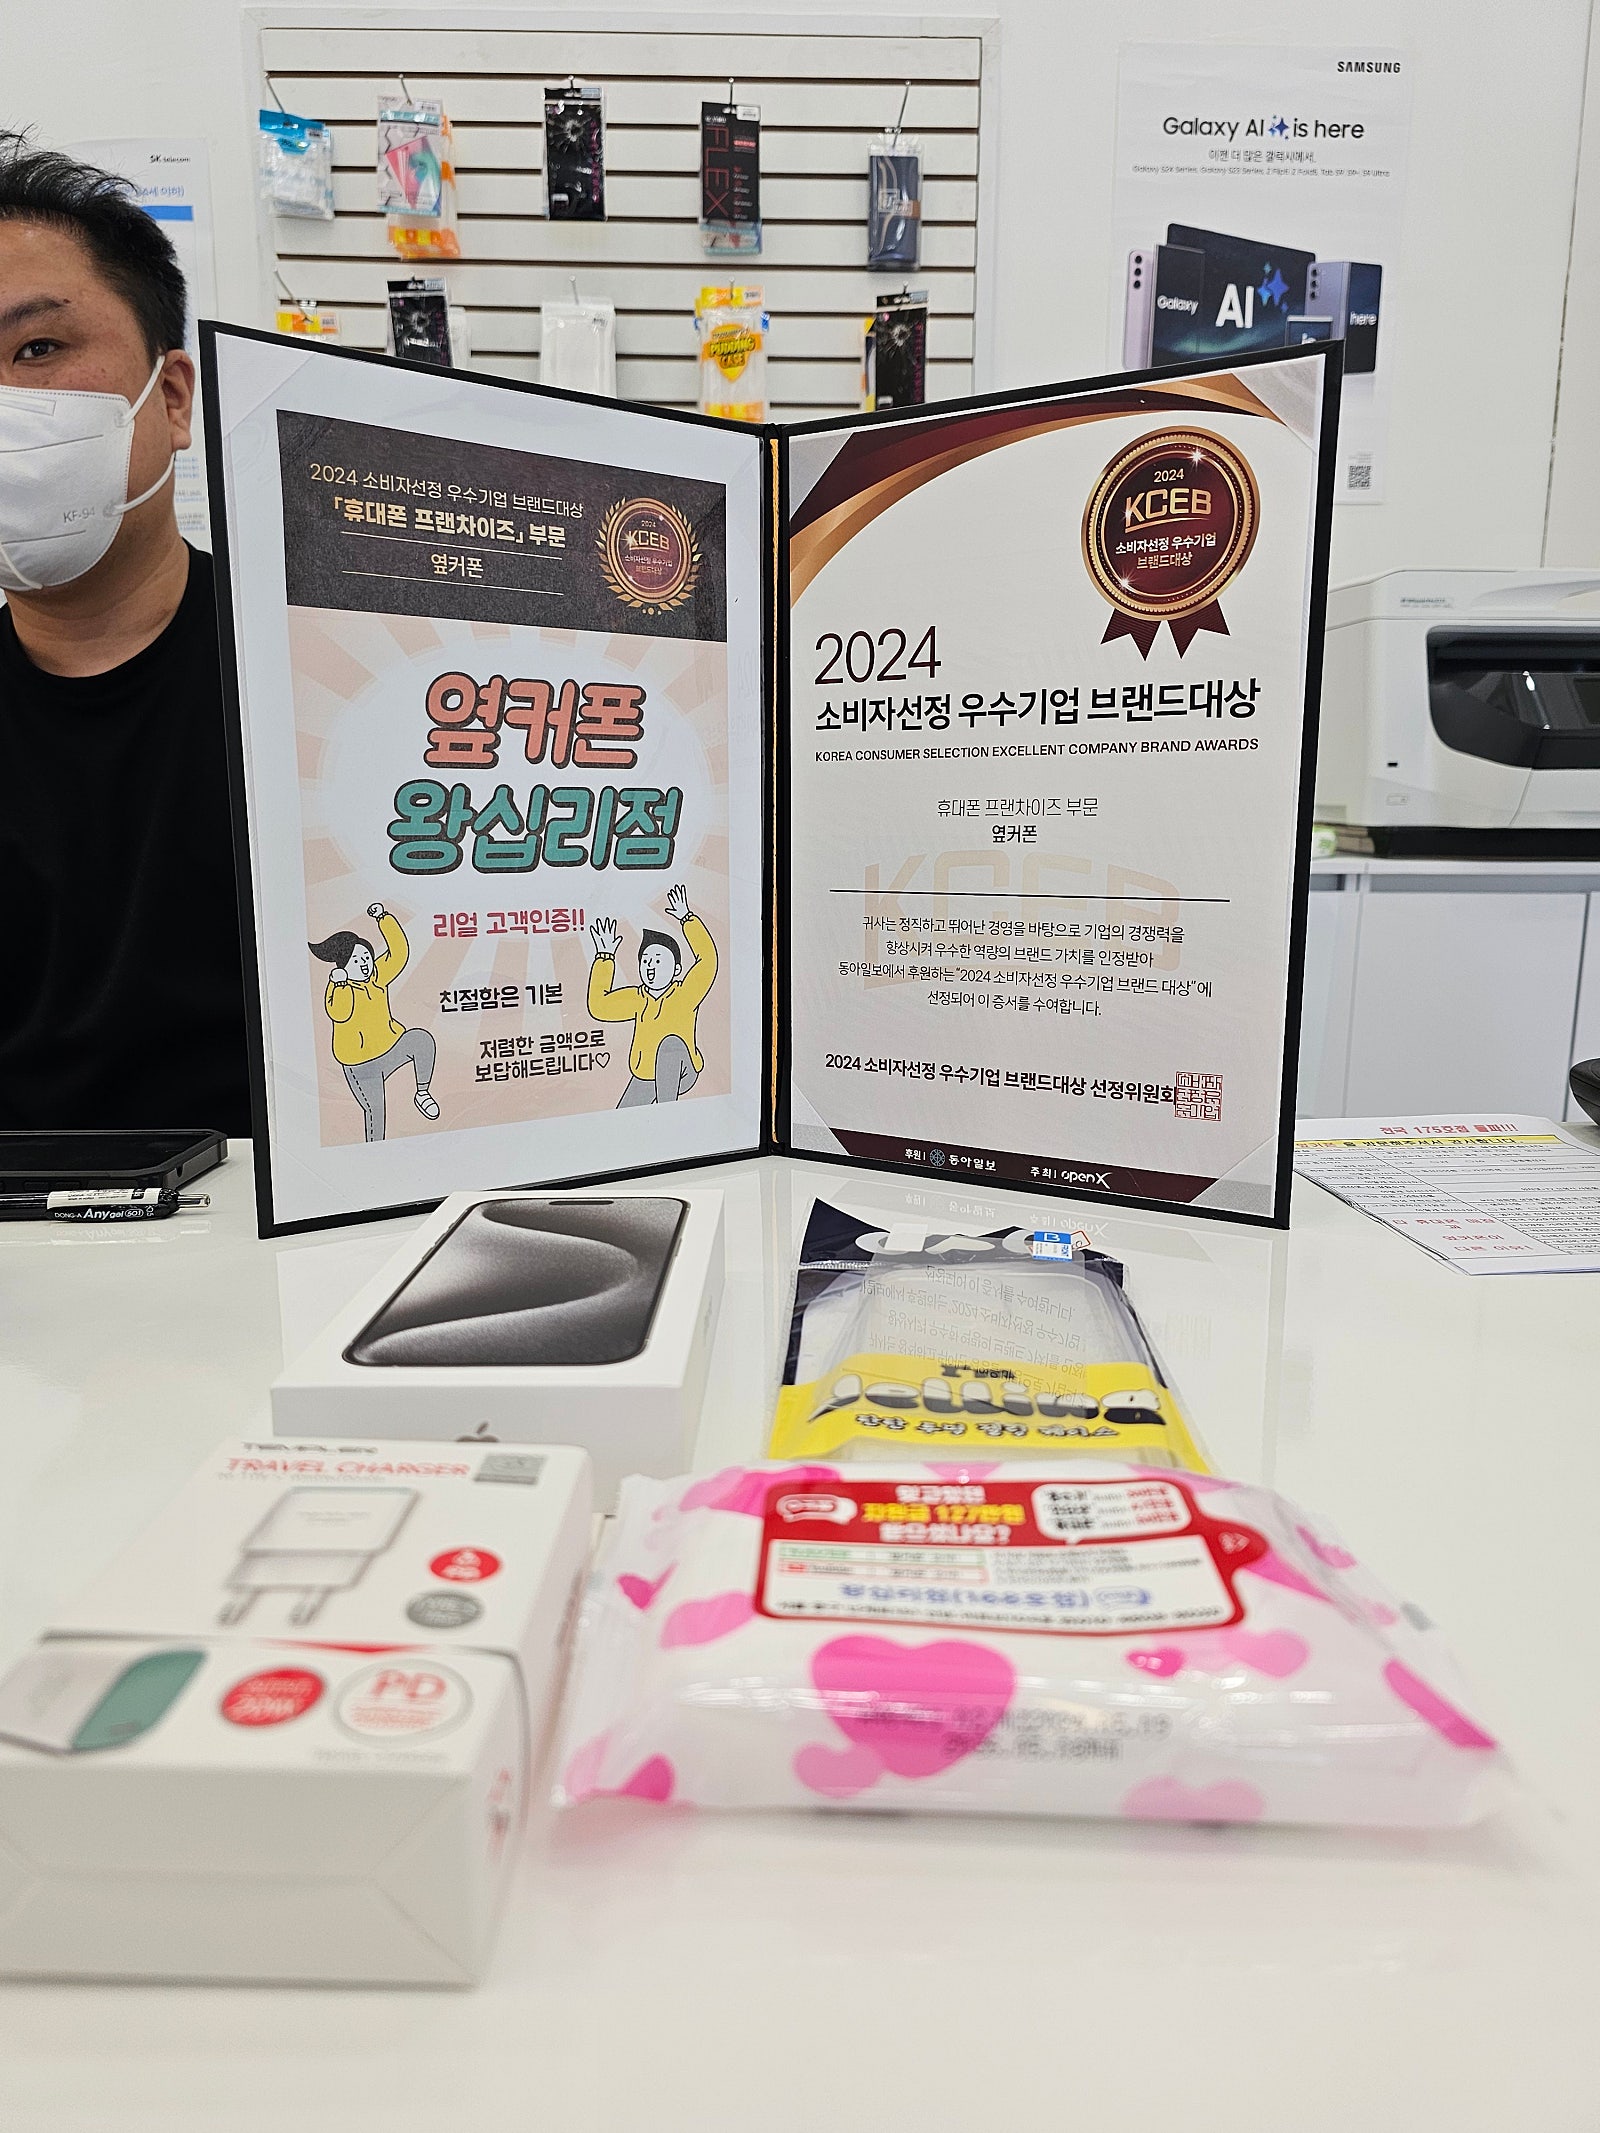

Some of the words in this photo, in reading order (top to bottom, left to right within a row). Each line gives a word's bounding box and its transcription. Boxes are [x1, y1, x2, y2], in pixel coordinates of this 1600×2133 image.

[1337, 61, 1401, 74] SAMSUNG
[1163, 116, 1240, 142] Galaxy
[1245, 118, 1264, 136] AI
[1293, 118, 1308, 138] is
[1313, 119, 1365, 139] here
[704, 126, 730, 217] FLEX
[1157, 295, 1198, 315] Galaxy
[1215, 283, 1255, 329] AI
[1349, 311, 1377, 327] here
[710, 338, 755, 357] PUDDING
[1153, 469, 1184, 483] 2024
[310, 463, 358, 486] 2024
[362, 470, 443, 499] 소비자선정
[447, 483, 508, 508] 우수기업
[512, 492, 584, 519] 브랜드대상
[63, 507, 96, 524] KF-94
[1125, 487, 1212, 533] KCEB
[528, 523, 566, 548] 부문
[641, 520, 657, 528] 2024
[628, 530, 669, 552] KCEB
[1115, 536, 1170, 555] 소비자선정
[1171, 532, 1217, 550] 우수기업
[430, 553, 484, 579] 옆커폰
[1136, 552, 1193, 570] 브랜드대상
[813, 625, 942, 685] 2024
[815, 693, 952, 732] 소비자선정
[957, 686, 1080, 729] 우수기업
[1086, 677, 1262, 723] 브랜드대상
[423, 671, 647, 770] 옆커폰
[815, 750, 853, 763] KOREA
[855, 748, 921, 762] CONSUMER
[922, 746, 990, 760] SELECTION
[991, 744, 1066, 758] EXCELLENT
[1068, 742, 1138, 756] COMPANY
[1140, 739, 1192, 753] BRAND
[1194, 738, 1259, 752] AWARDS
[936, 800, 981, 818] 휴대폰
[984, 798, 1062, 818] 프랜차이즈
[1066, 798, 1099, 817] 부문
[387, 779, 684, 876] 왕십리점
[991, 825, 1038, 844] 옆커폰
[432, 911, 478, 938] 리얼
[486, 908, 585, 935] 고객인증!!
[862, 915, 897, 932] 귀사는
[899, 918, 947, 934] 정직하고
[948, 919, 986, 936] 뛰어난
[988, 920, 1026, 938] 경영을
[1028, 922, 1082, 939] 바탕으로
[1084, 924, 1125, 942] 기업의
[1128, 925, 1185, 944] 경쟁력을
[885, 941, 933, 957] 향상시켜
[934, 943, 971, 959] 우수한
[973, 944, 1012, 961] 역량의
[1014, 946, 1053, 963] 브랜드
[1055, 948, 1095, 966] 가치를
[1098, 950, 1155, 969] 인정받아
[838, 961, 906, 979] 동아일보에서
[907, 966, 955, 983] 후원하는
[993, 970, 1058, 989] 소비자선정
[1060, 974, 1114, 992] 우수기업
[1116, 976, 1159, 994] 브랜드
[439, 985, 520, 1013] 친절함은
[525, 983, 563, 1005] 기본
[927, 990, 976, 1008] 선정되어
[977, 993, 990, 1009] 이
[992, 994, 1031, 1011] 증서를
[1033, 997, 1102, 1017] 수여합니다.
[479, 1035, 535, 1060] 저렴한
[539, 1029, 606, 1054] 금액으로
[825, 1053, 862, 1072] 2024
[863, 1058, 936, 1081] 소비자선정
[938, 1064, 1000, 1087] 우수기업
[1003, 1070, 1087, 1096] 브랜드대상
[1089, 1079, 1177, 1106] 선정위원회
[904, 1147, 922, 1161] 후원
[949, 1154, 996, 1172] 동아일보
[1061, 1169, 1112, 1189] openX
[915, 1419, 967, 1438] 투명
[975, 1421, 1029, 1440] 젤링
[1036, 1423, 1121, 1440] 케이스
[226, 1457, 325, 1474] TRAVEL
[337, 1459, 470, 1477] CHARGER
